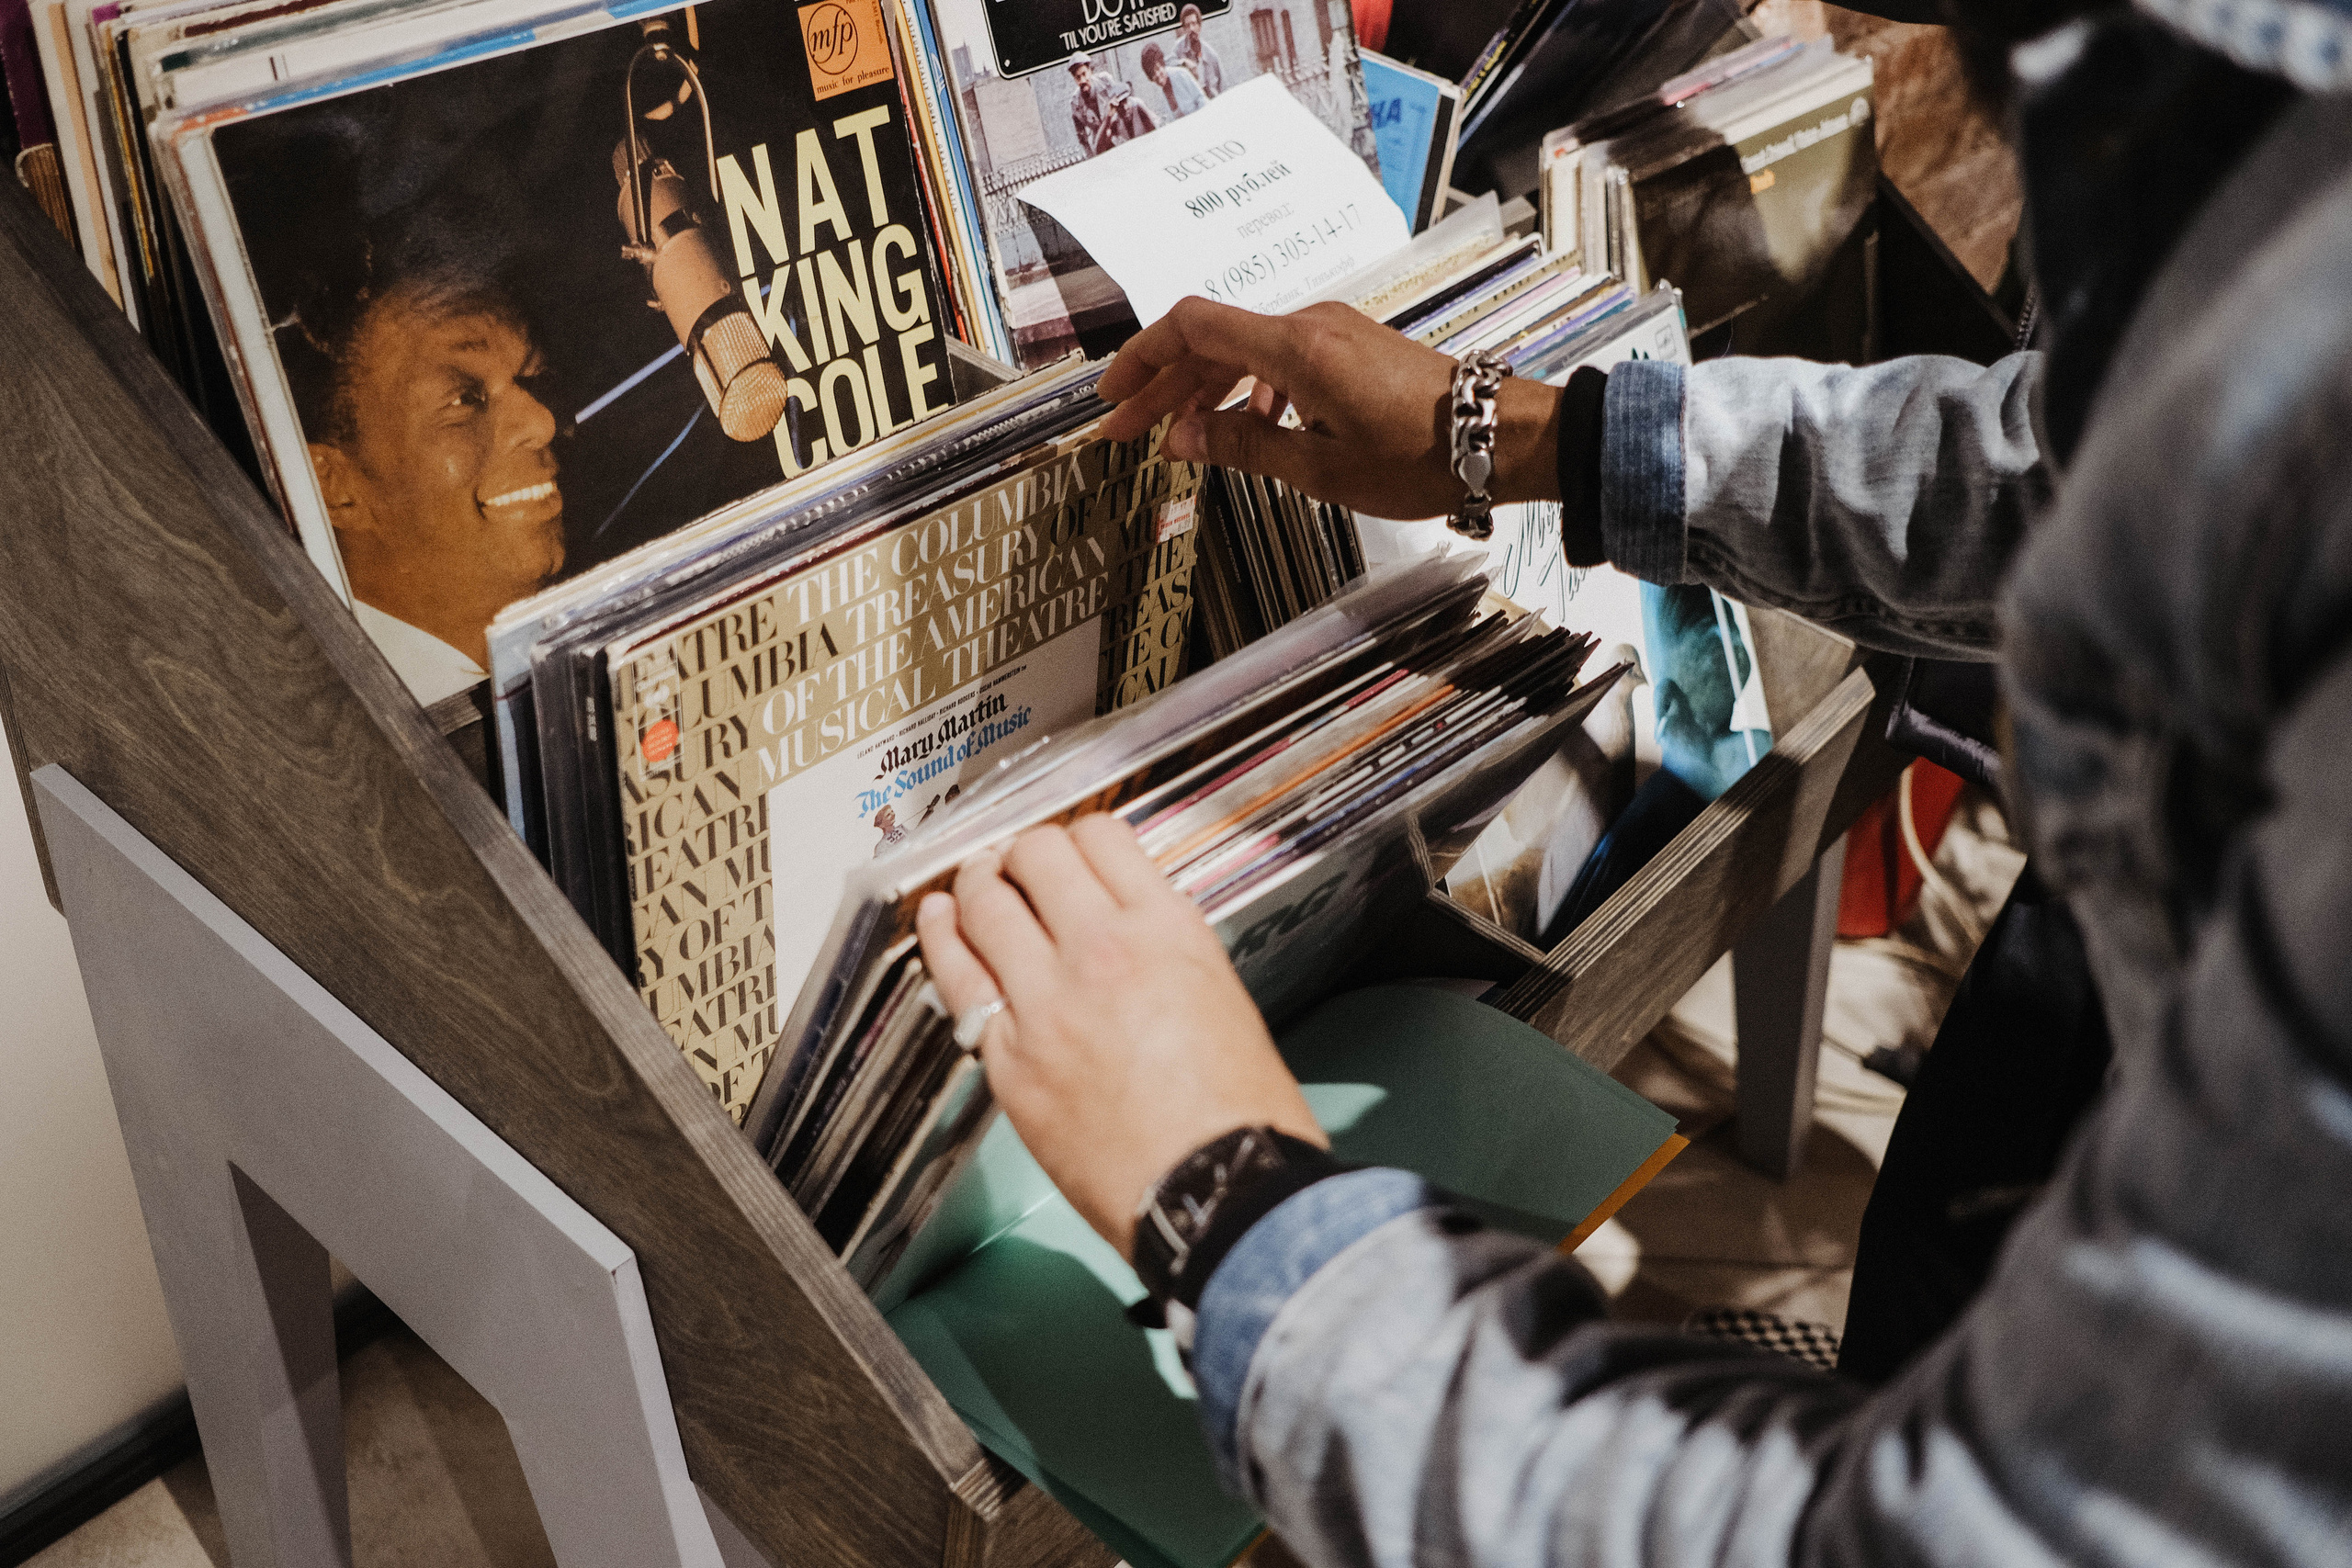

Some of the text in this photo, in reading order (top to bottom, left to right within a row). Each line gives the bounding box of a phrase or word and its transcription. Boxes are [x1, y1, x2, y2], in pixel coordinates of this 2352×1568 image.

[809, 9, 854, 63] mfp
[906, 15, 930, 90] NSTRUMENTALLY
[1078, 17, 1124, 46] YOU'RE
[1123, 2, 1177, 33] SATISFIED
[817, 66, 889, 94] music for pleasure
[716, 104, 891, 277] NAT
[1164, 140, 1246, 183] ВСЕ ПО
[1184, 160, 1293, 220] 800 рублей
[741, 223, 932, 373] KING
[1204, 203, 1362, 303] 8 (985) 305-14-17
[774, 322, 950, 479] COLE
[787, 548, 880, 626] THE
[890, 456, 1086, 577] COLUMBIA
[846, 516, 1046, 651] TREASURY
[1050, 496, 1097, 546] OF
[756, 666, 936, 790] MUSICAL
[944, 572, 1109, 687] THEATRE
[1118, 535, 1183, 597] THE
[763, 672, 820, 735] OF
[826, 627, 913, 702] THE
[921, 536, 1106, 660] AMERICAN
[874, 693, 1010, 781] Mary Martin
[875, 733, 895, 750] HAYWARD
[899, 722, 917, 737] RICHARD
[917, 711, 936, 728] HALLIDAY
[939, 701, 956, 716] RICHARD
[957, 691, 976, 706] RODGERS
[978, 681, 992, 694] OSCAR
[992, 668, 1021, 687] HAMMERSTEIN
[854, 705, 1032, 818] The Sound of Music
[679, 899, 737, 961] OF
